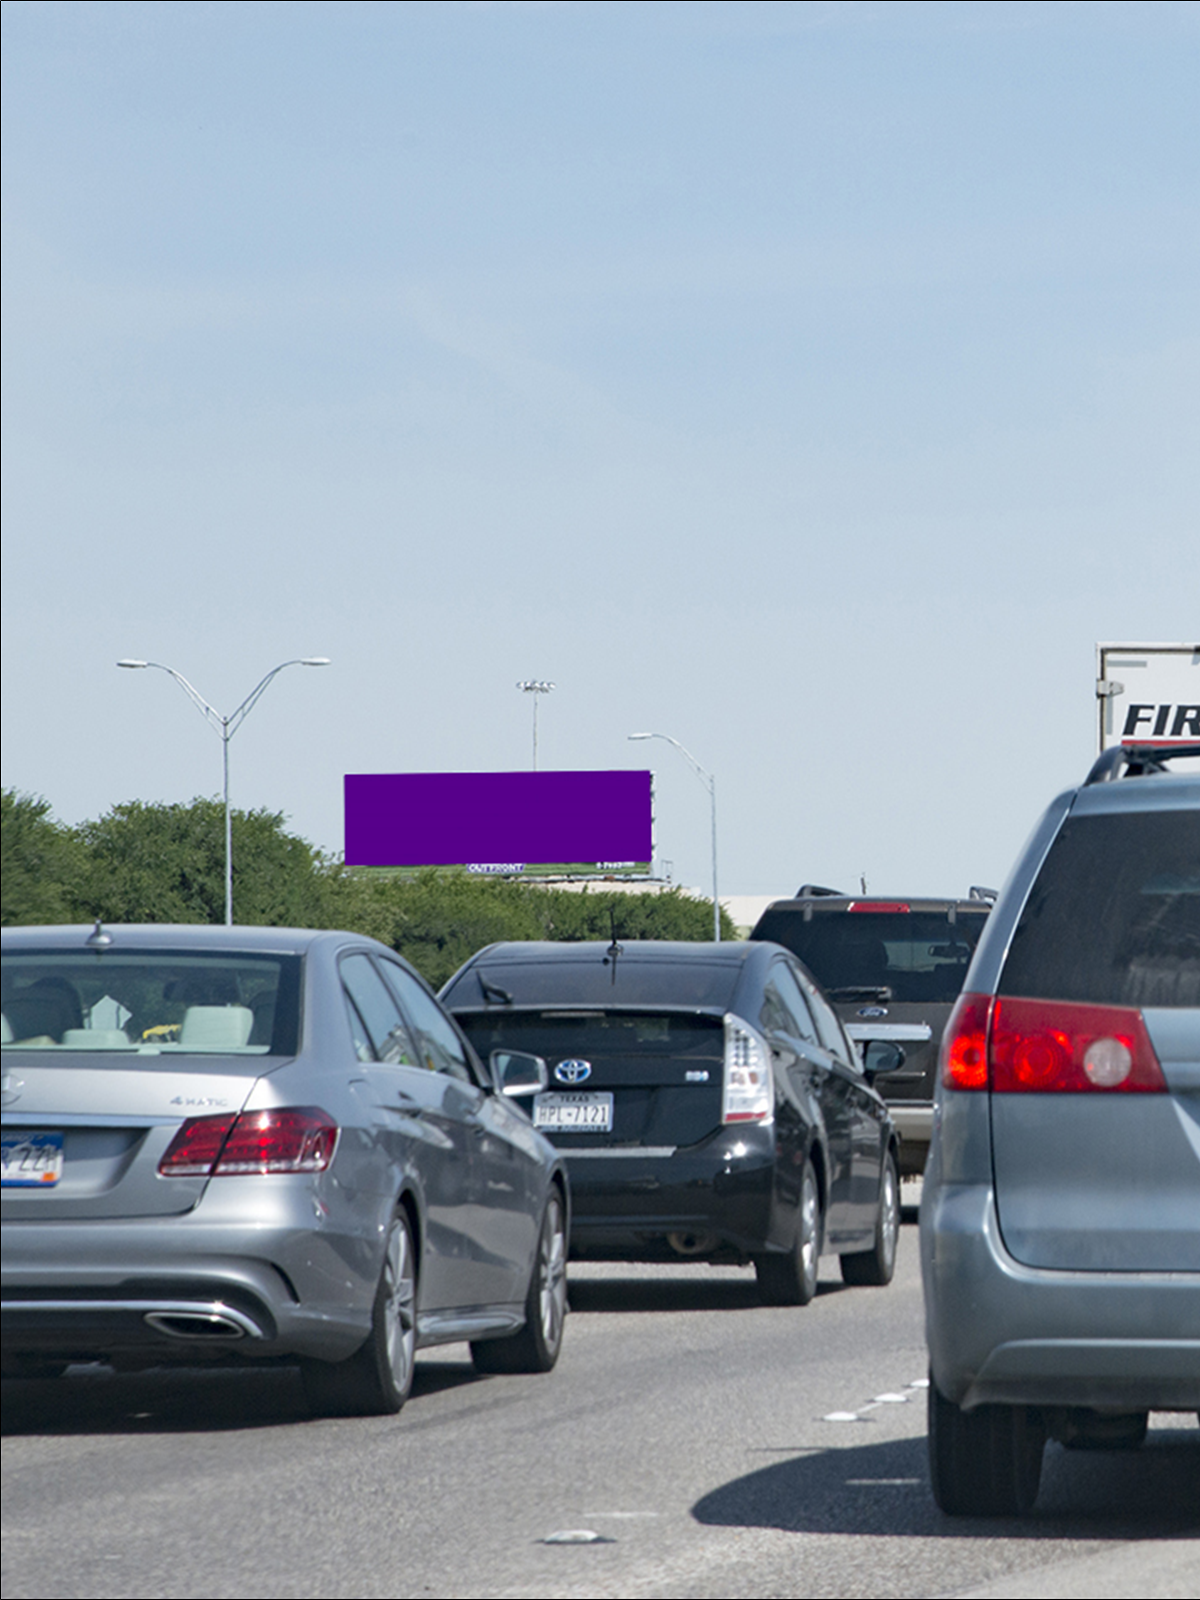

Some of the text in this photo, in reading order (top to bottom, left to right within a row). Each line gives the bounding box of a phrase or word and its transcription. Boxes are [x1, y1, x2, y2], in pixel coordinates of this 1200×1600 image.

[468, 863, 524, 874] OUTFRONT
[559, 1095, 590, 1103] TEXAS
[538, 1105, 608, 1124] HPL-7121
